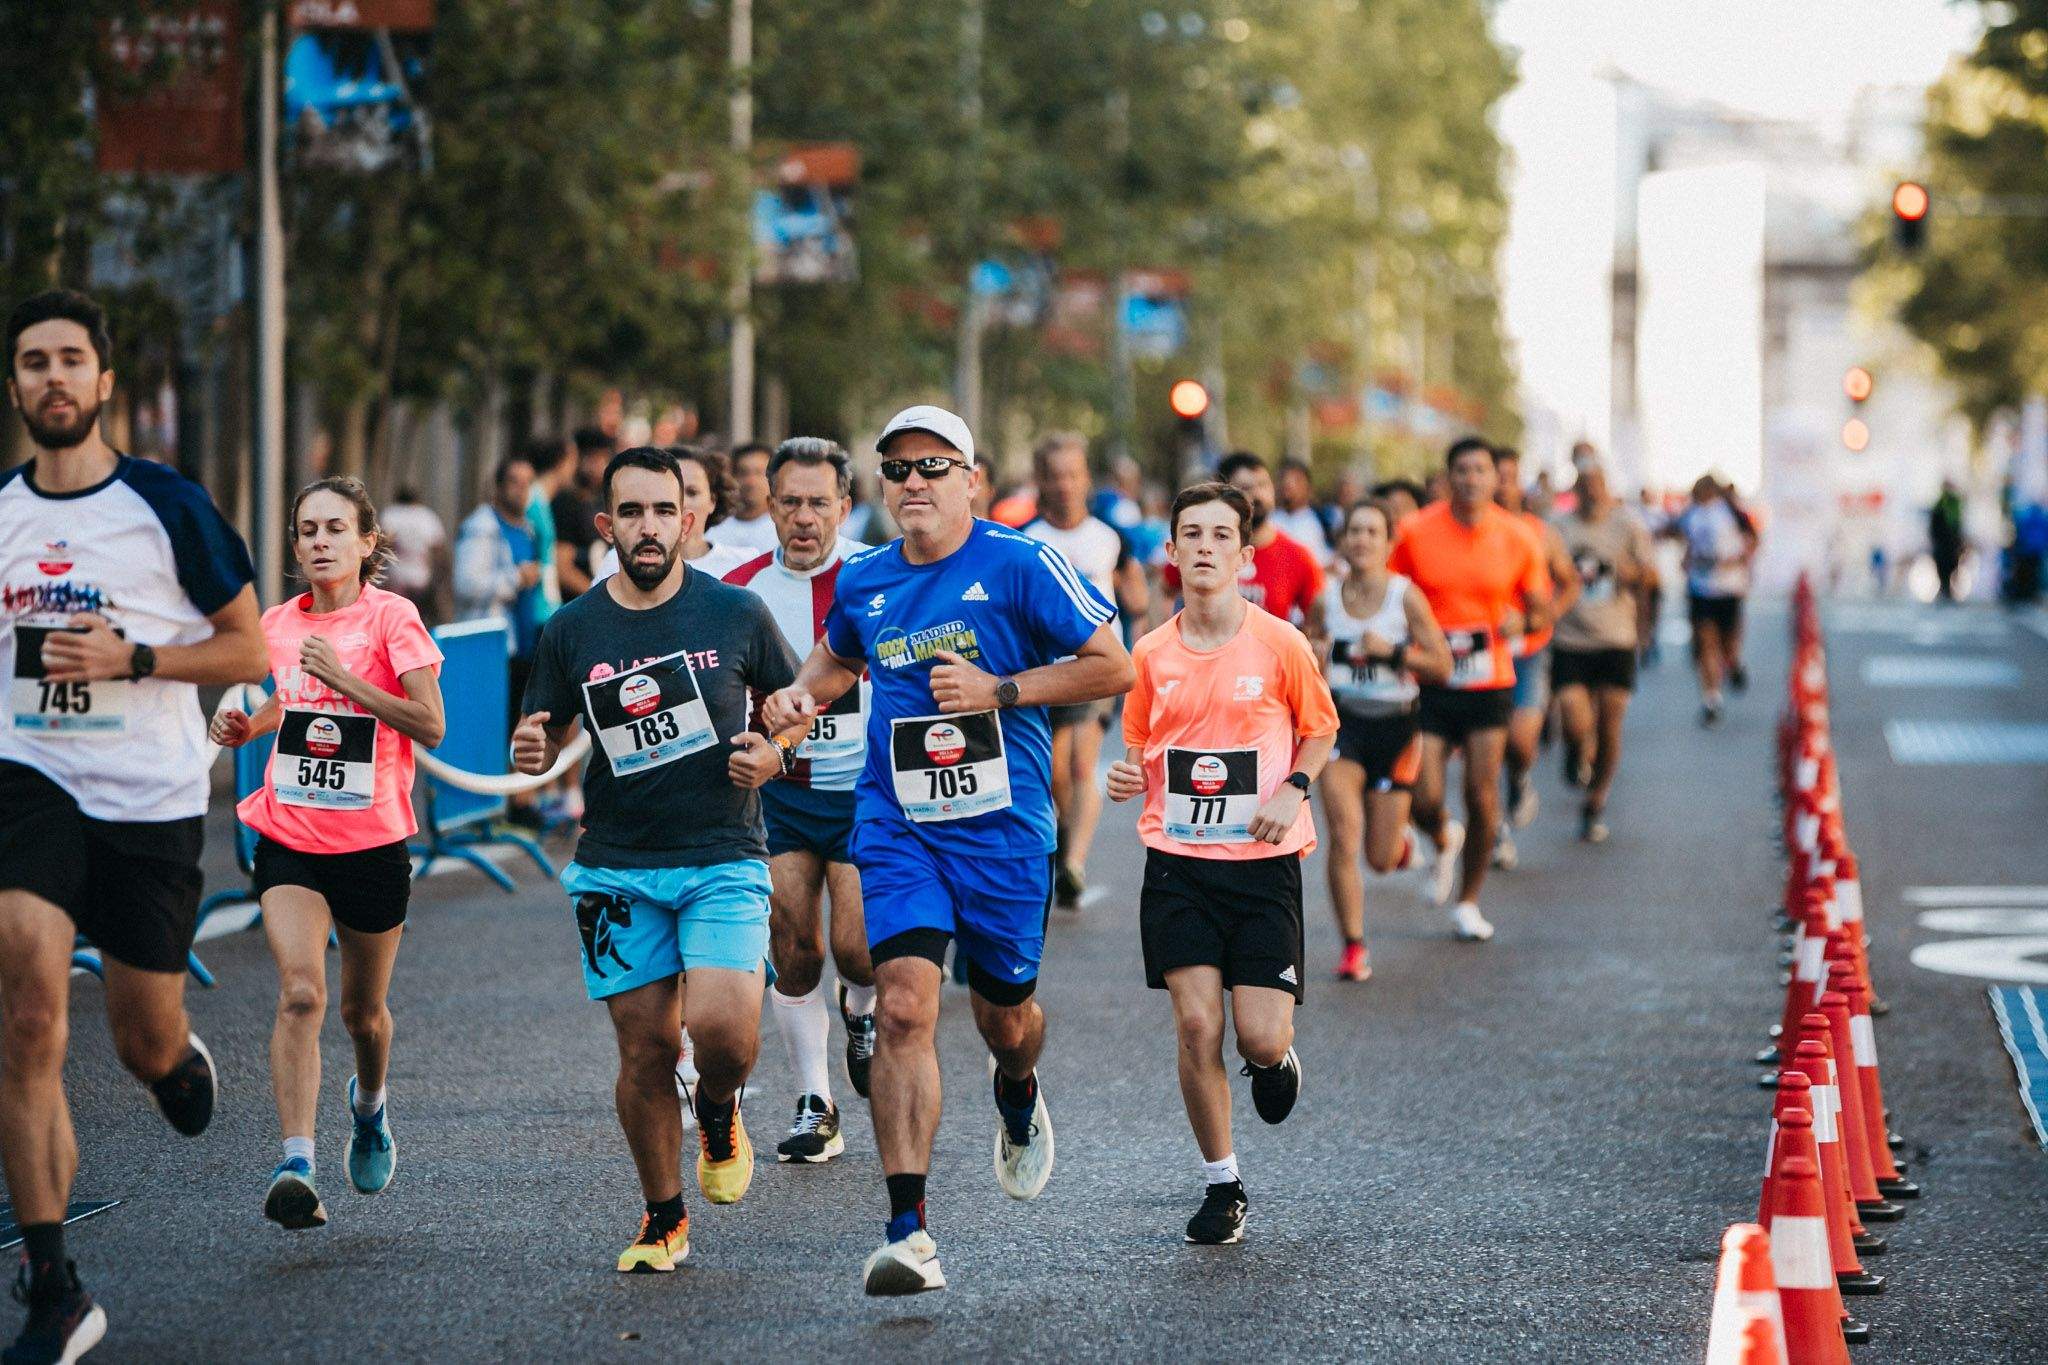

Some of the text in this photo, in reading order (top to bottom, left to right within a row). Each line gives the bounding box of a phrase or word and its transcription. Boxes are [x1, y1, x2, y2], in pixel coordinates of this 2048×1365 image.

[961, 593, 989, 601] adidas
[911, 622, 964, 645] MADRID
[877, 636, 910, 660] ROCK
[37, 680, 91, 714] 745
[625, 711, 680, 751] 783
[807, 717, 837, 741] 95
[297, 758, 346, 791] 545
[924, 765, 978, 800] 705
[1190, 797, 1227, 825] 777
